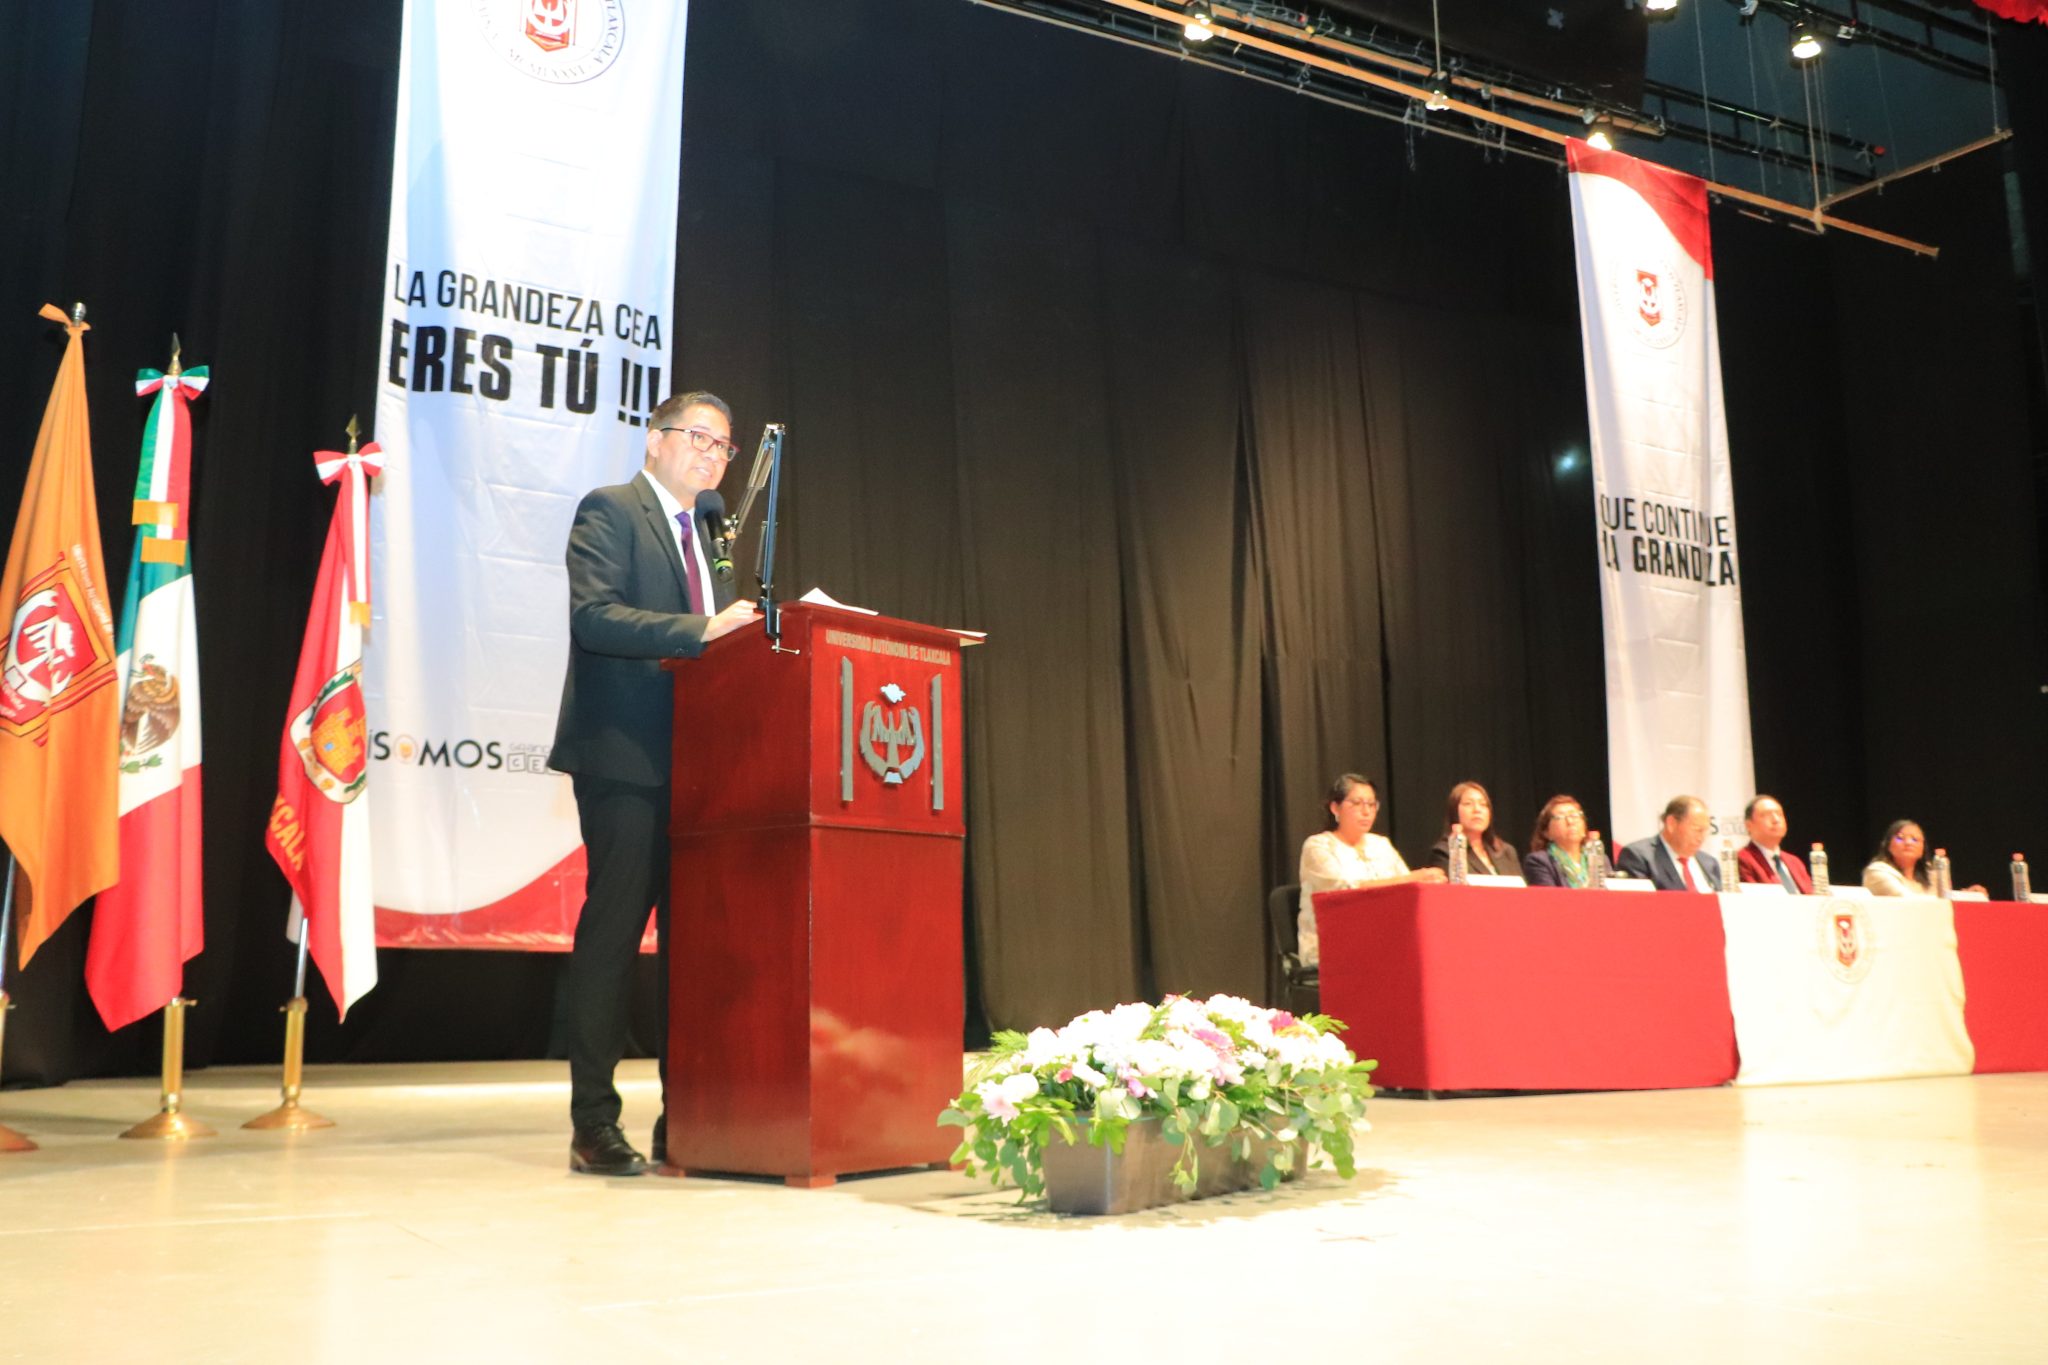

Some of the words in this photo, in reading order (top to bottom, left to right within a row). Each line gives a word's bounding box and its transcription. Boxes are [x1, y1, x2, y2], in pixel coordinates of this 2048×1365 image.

[394, 263, 427, 309] LA
[437, 269, 604, 337] GRANDEZA
[614, 303, 662, 350] CEA
[388, 318, 513, 402] ERES
[536, 338, 600, 415] TÚ
